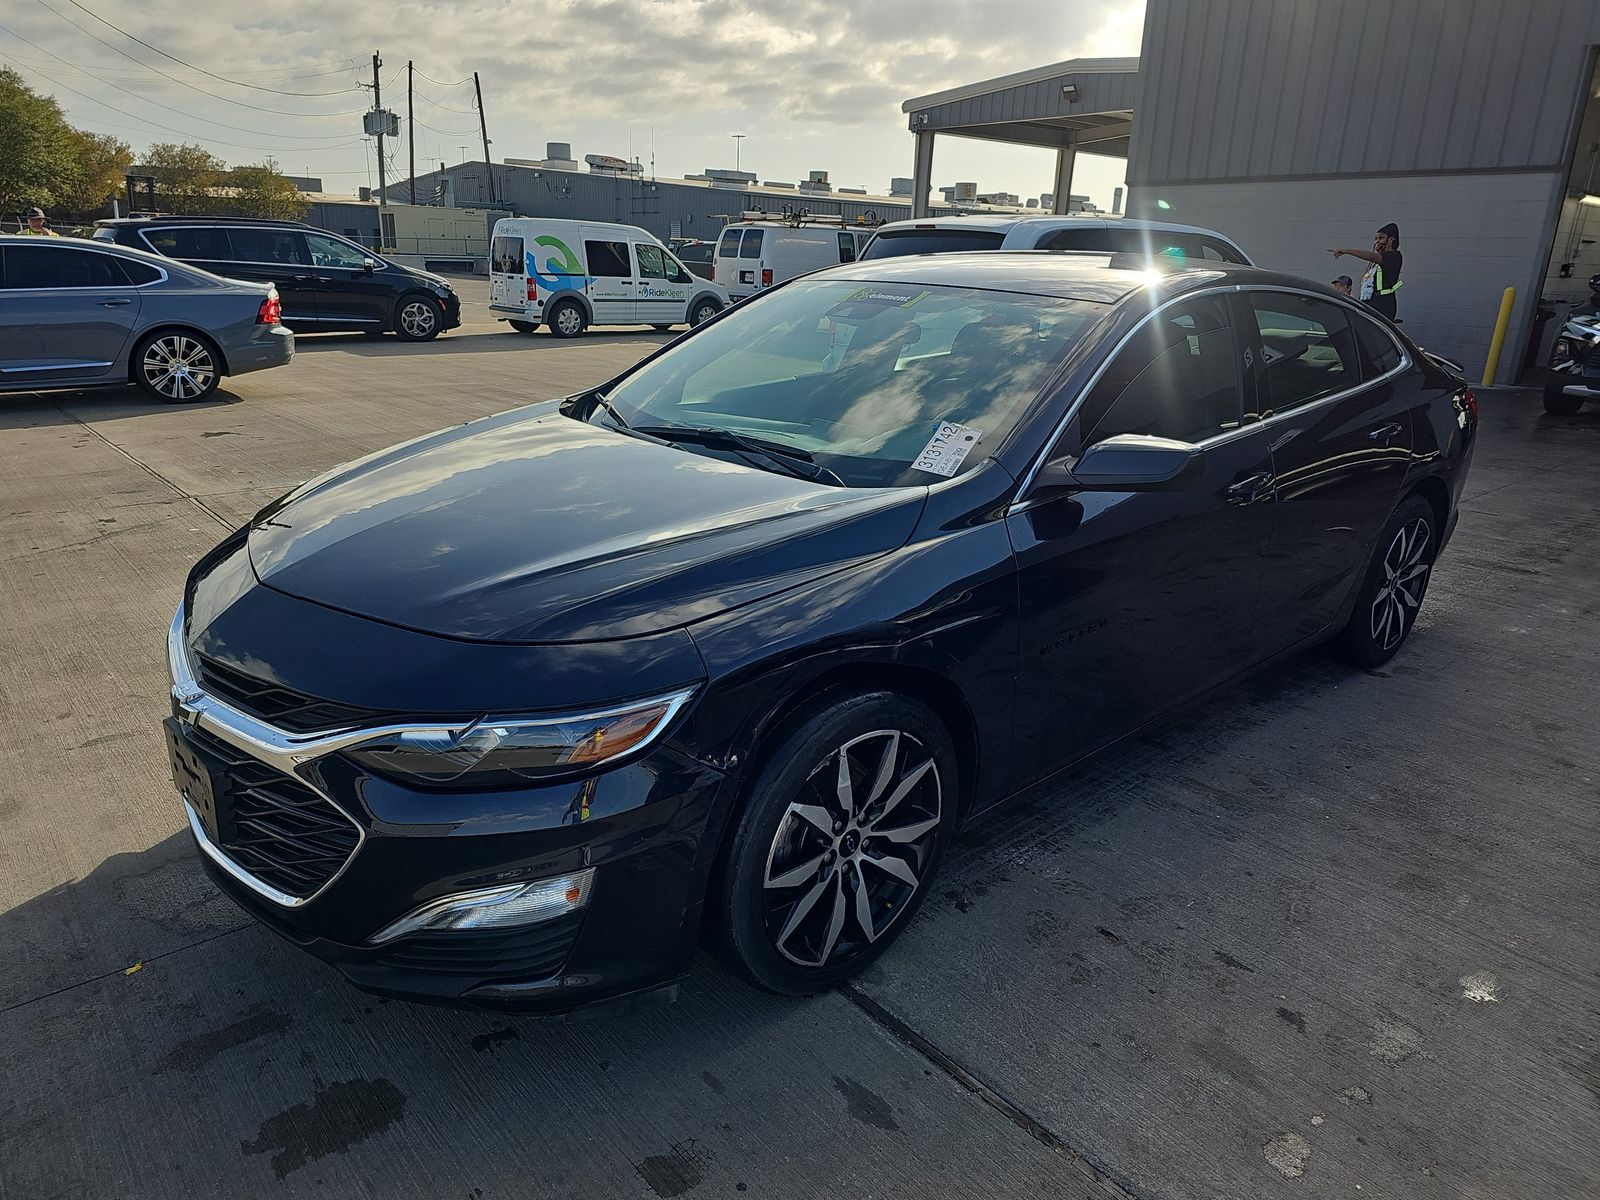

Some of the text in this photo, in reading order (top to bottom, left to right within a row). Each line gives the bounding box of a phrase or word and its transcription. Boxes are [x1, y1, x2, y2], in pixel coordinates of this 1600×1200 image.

[648, 288, 685, 298] RideKleen
[869, 292, 912, 302] element
[917, 426, 959, 469] 3131742
